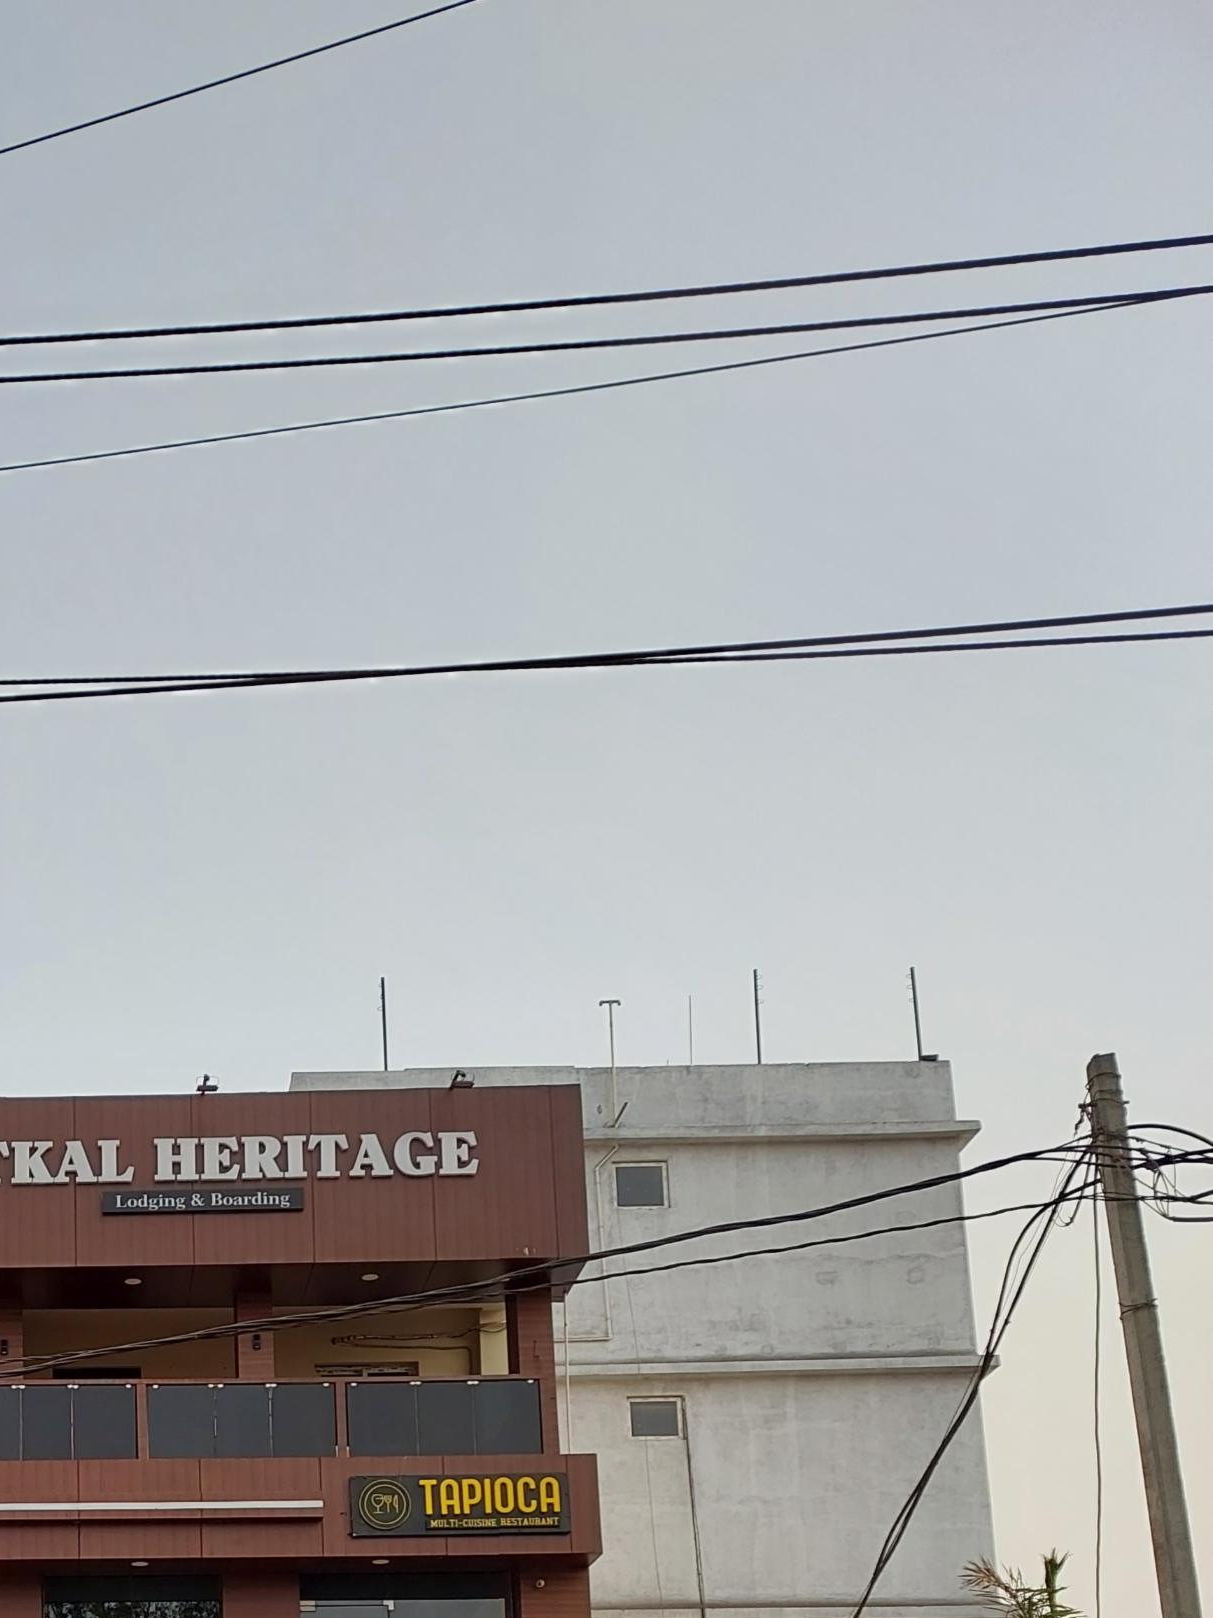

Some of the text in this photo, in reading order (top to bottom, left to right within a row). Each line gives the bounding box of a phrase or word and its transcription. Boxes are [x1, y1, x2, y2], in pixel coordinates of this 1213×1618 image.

[153, 1130, 480, 1183] HERITAGE
[115, 1192, 291, 1211] Lodging & Boarding
[419, 1476, 561, 1516] TAPIOCA
[430, 1516, 560, 1528] MULTI-CUISINE RESTAURANT
